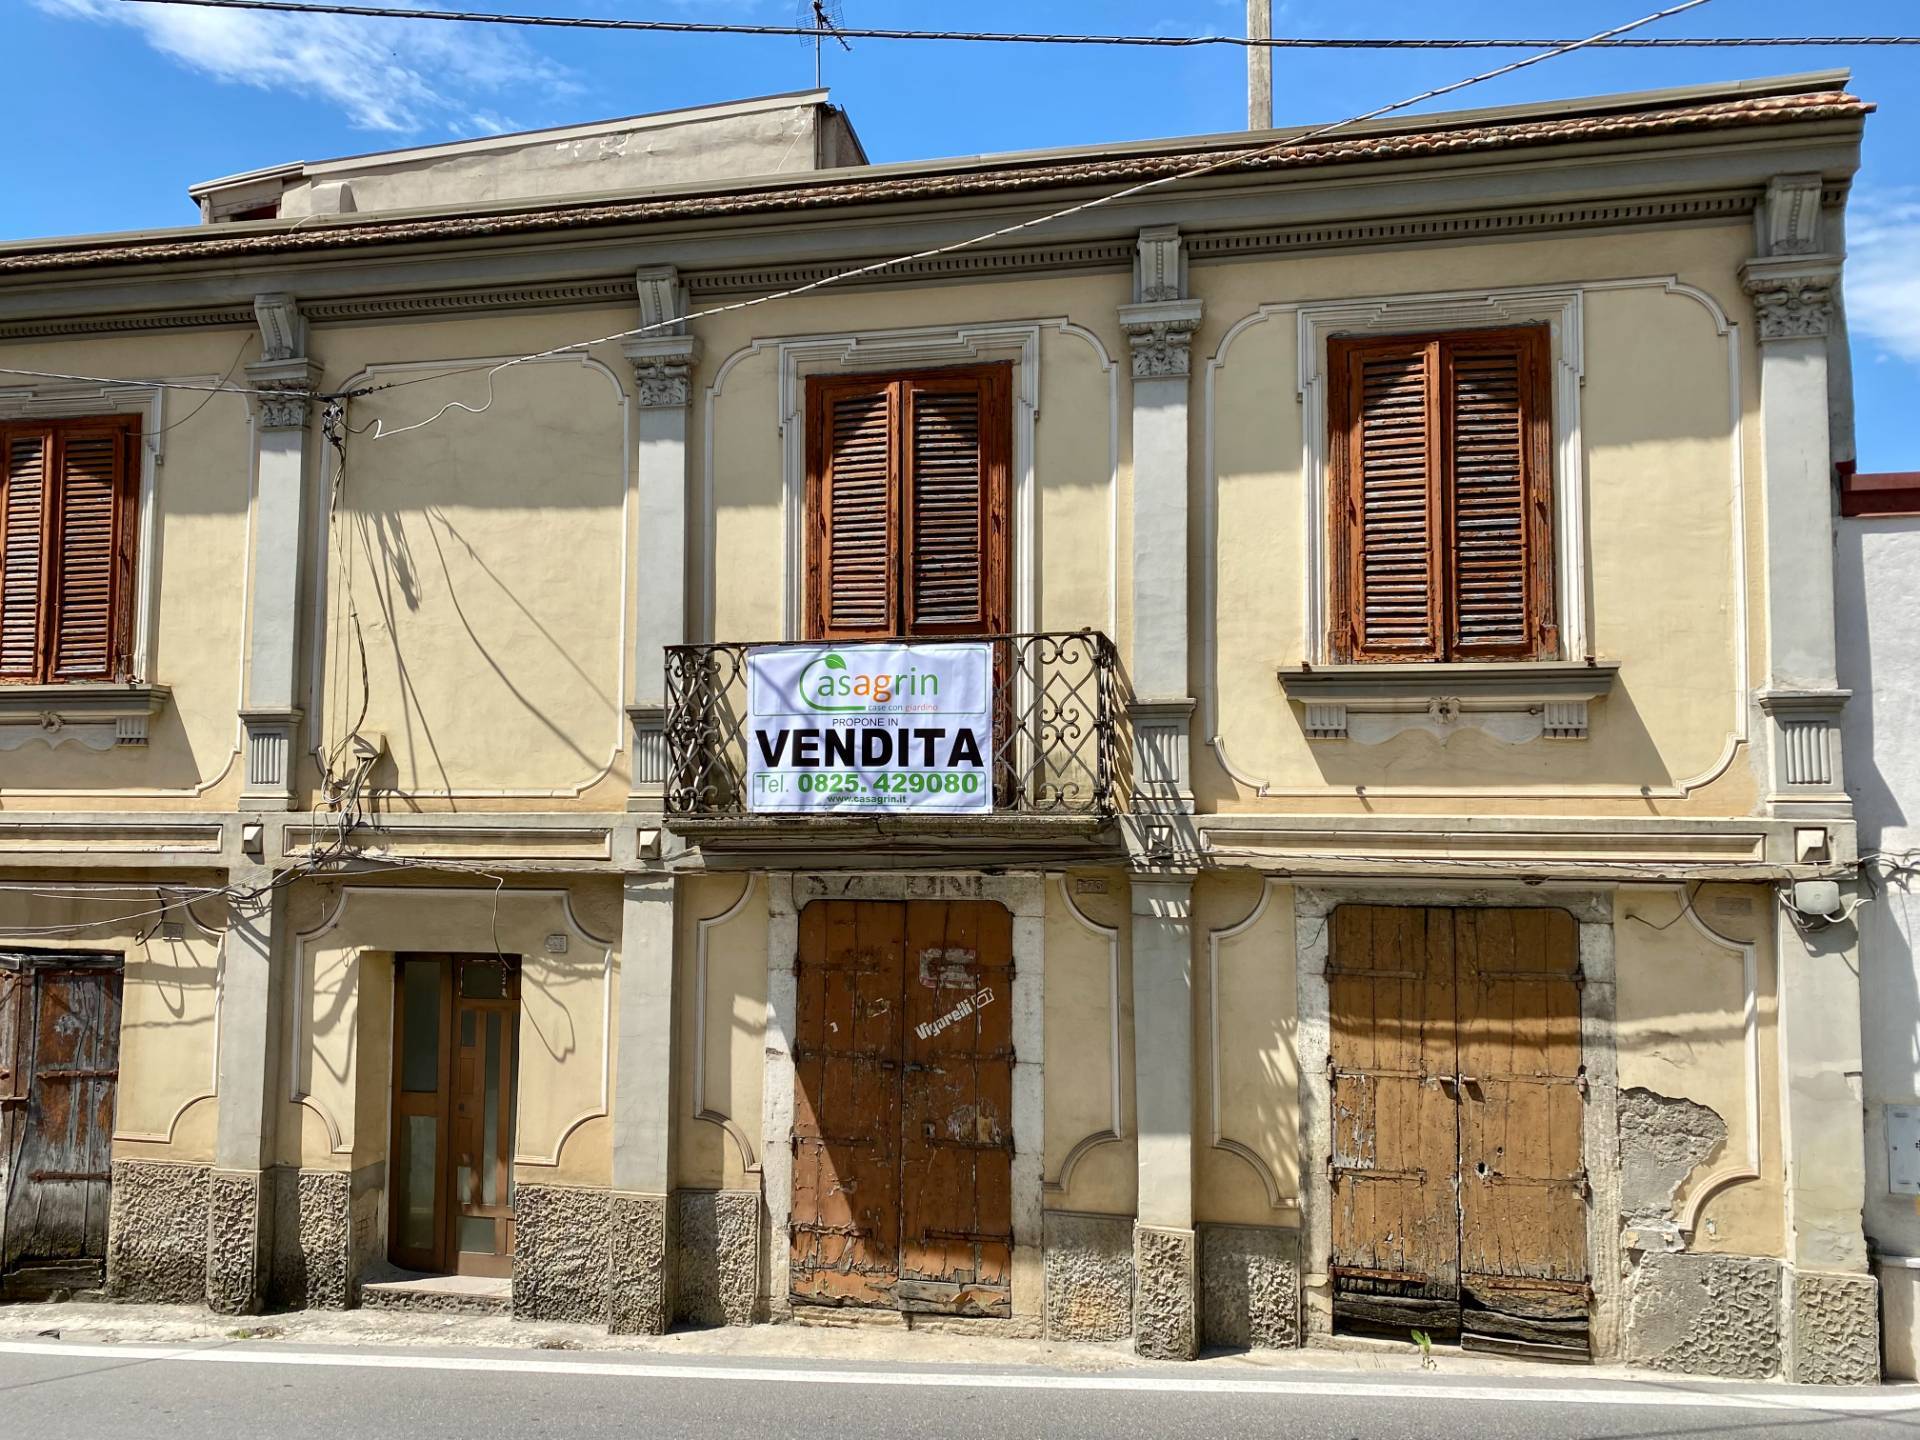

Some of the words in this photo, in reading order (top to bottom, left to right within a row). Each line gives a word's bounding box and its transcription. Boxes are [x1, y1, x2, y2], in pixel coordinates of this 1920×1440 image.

[868, 703, 887, 712] case
[888, 703, 903, 712] con
[905, 701, 939, 714] giardino
[832, 718, 885, 728] PROPONE
[888, 717, 898, 727] IN
[755, 728, 984, 768] VENDITA
[756, 774, 789, 793] Tel.
[873, 773, 978, 793] 429080
[827, 794, 906, 804] www.casagrin.it
